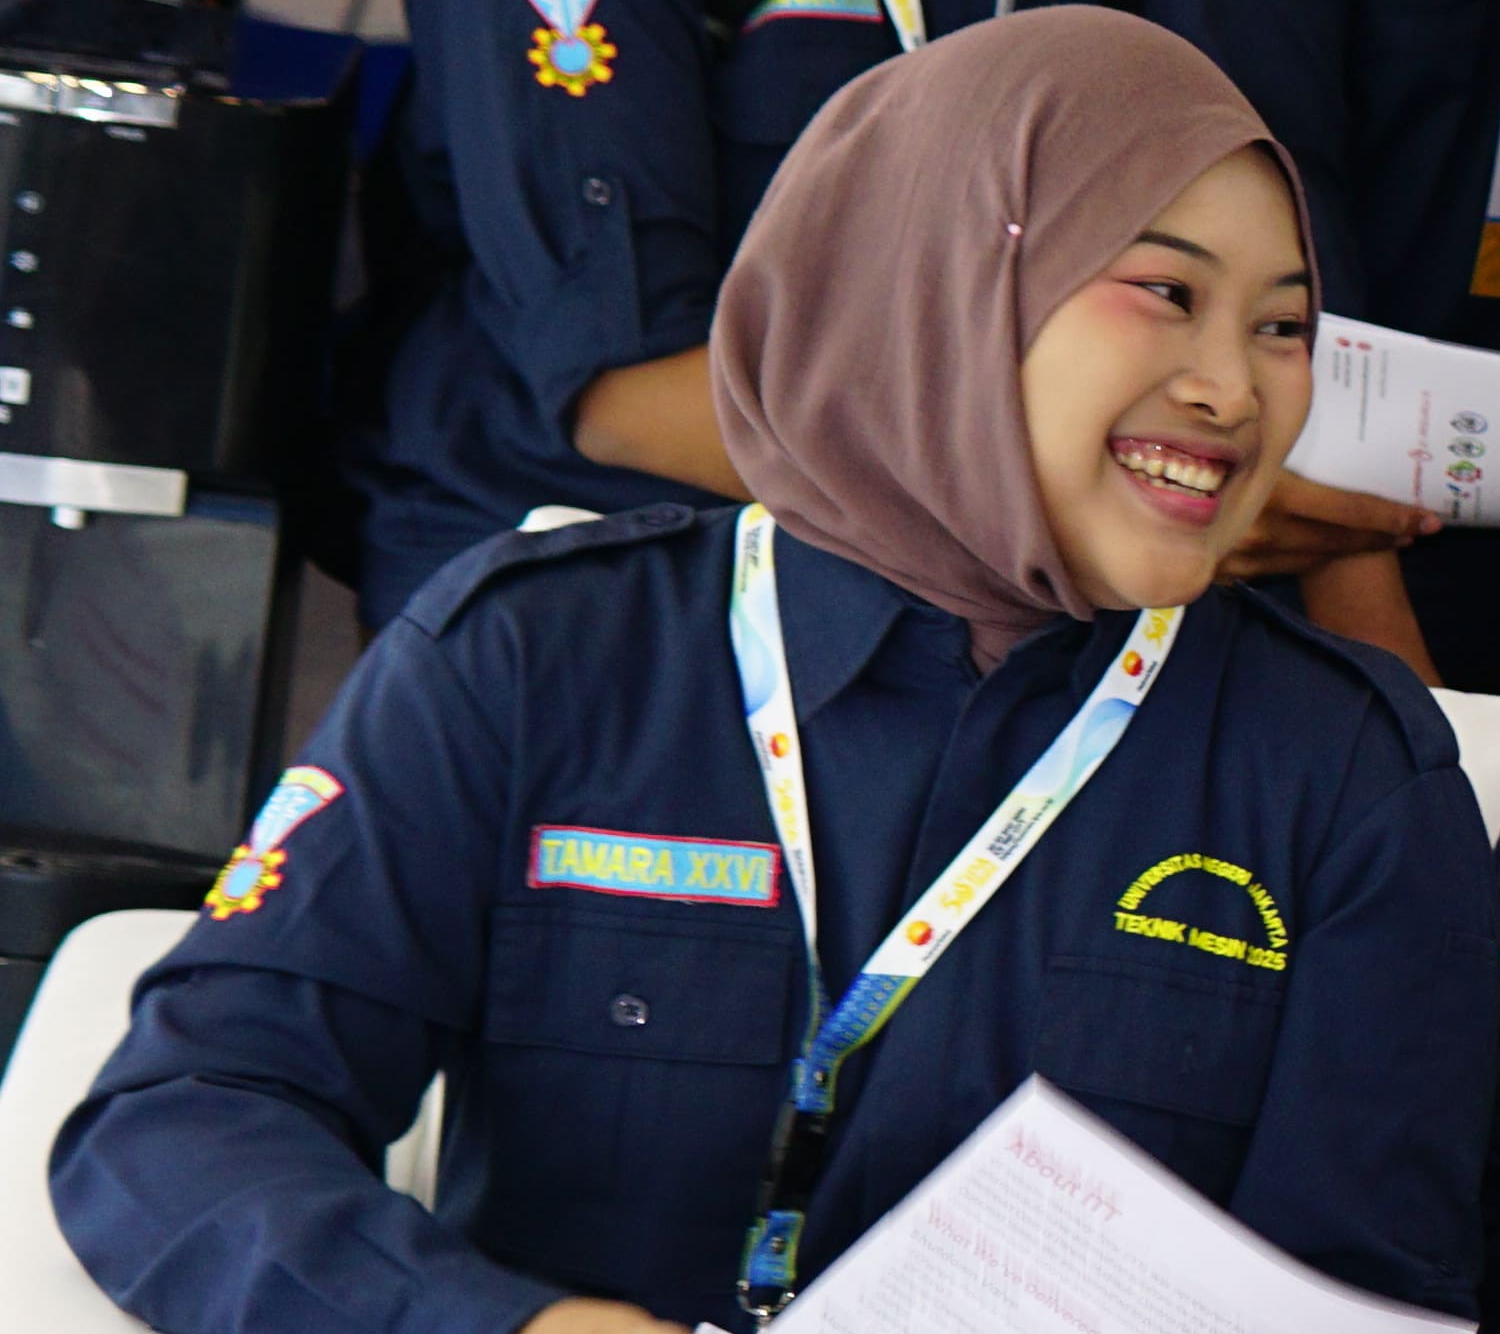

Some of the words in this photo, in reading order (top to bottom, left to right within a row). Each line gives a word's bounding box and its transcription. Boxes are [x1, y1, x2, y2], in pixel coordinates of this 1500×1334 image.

[541, 838, 676, 887] TAMARA
[685, 849, 770, 895] XXVI
[1116, 853, 1201, 911] UNIVERSITAS
[1113, 911, 1188, 943] TEKNIK
[1188, 927, 1247, 960] MESIN
